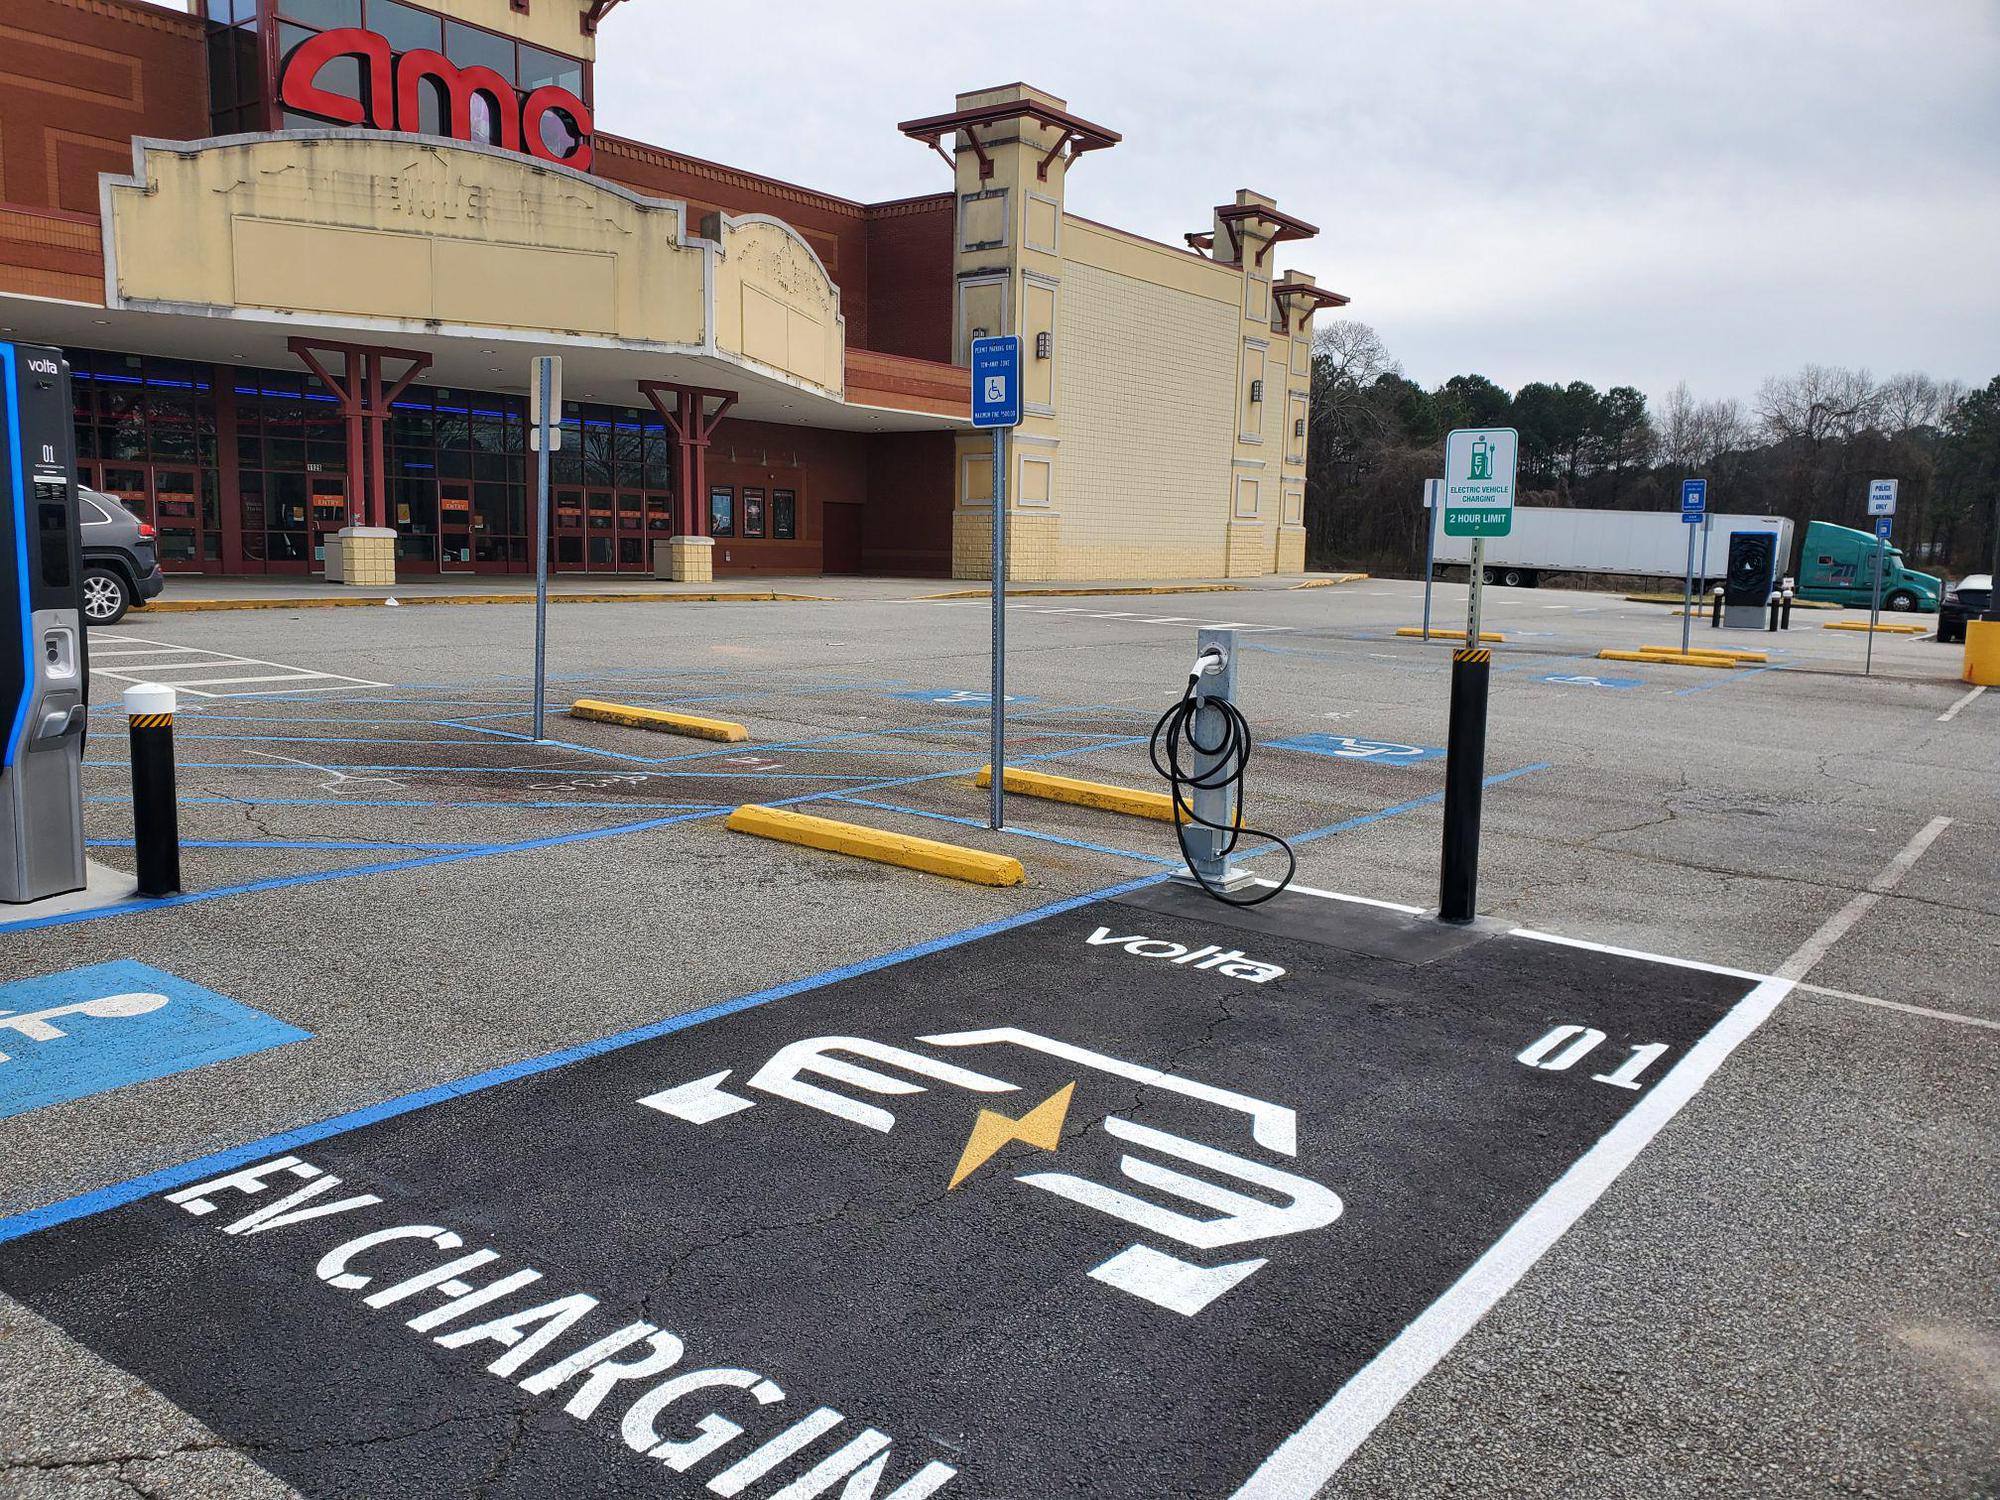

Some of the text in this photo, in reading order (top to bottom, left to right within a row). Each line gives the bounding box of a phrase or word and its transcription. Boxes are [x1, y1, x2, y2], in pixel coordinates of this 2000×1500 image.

[281, 27, 592, 173] amc
[28, 359, 58, 374] volta
[42, 444, 55, 463] 01
[1462, 495, 1496, 503] CHARGING
[1449, 514, 1506, 524] 2 HOUR LIMIT
[1085, 926, 1287, 984] volta
[1516, 1024, 1669, 1091] 01
[164, 1155, 384, 1237] EV
